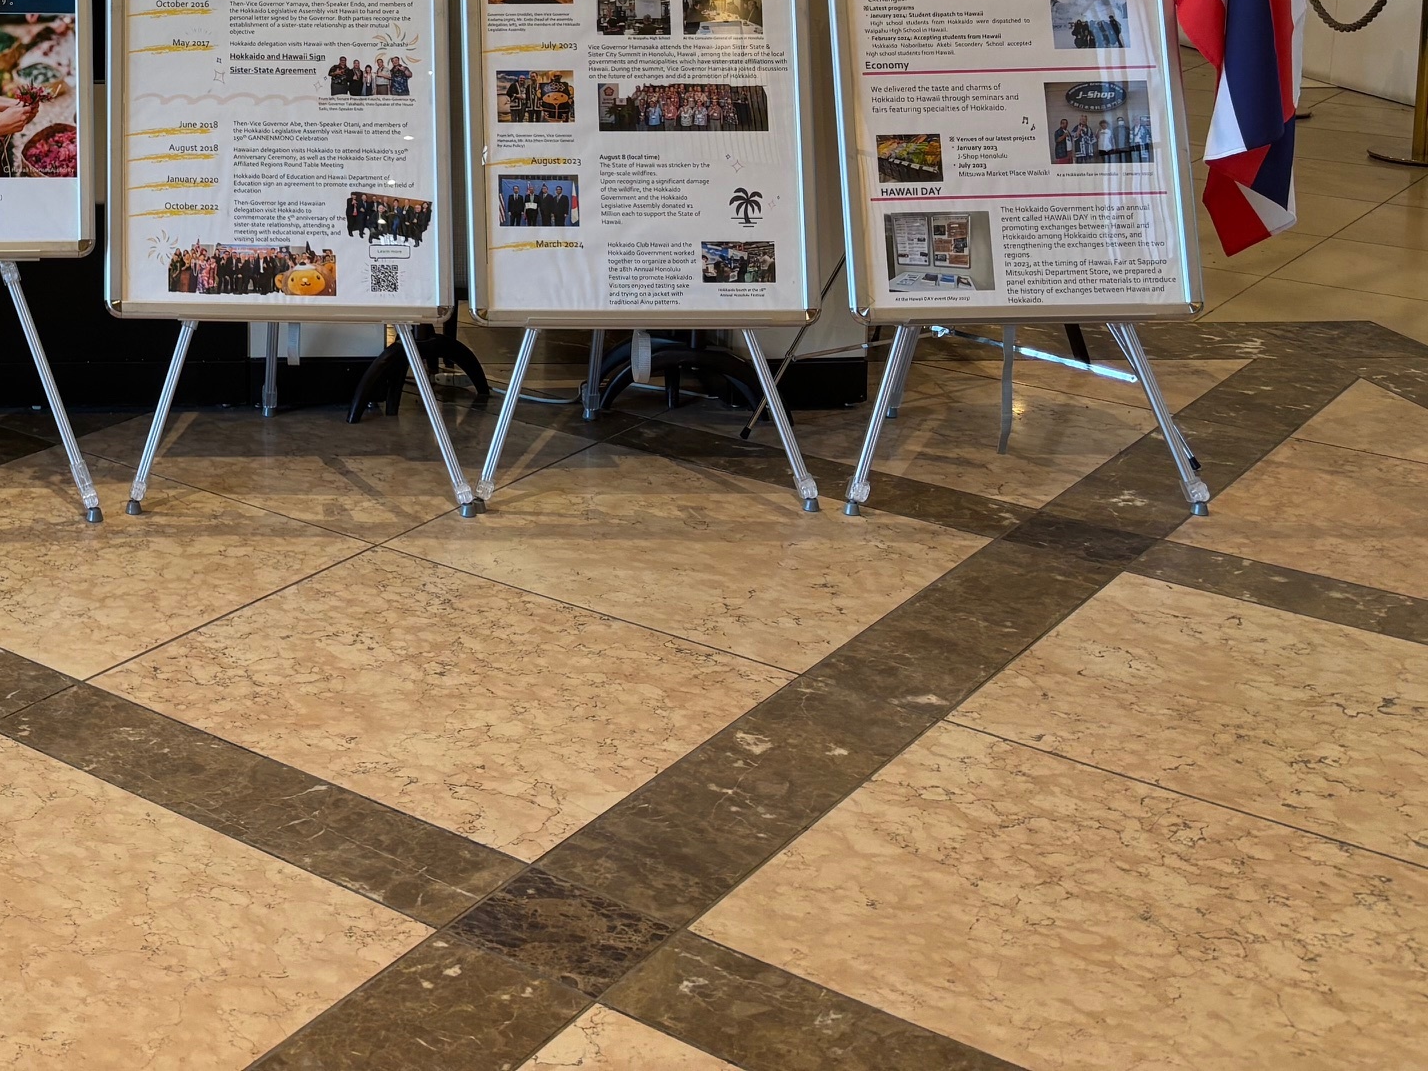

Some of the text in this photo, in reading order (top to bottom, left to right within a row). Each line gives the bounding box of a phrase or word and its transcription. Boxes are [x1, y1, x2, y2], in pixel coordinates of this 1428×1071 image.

[155, 0, 188, 7] October
[172, 38, 209, 48] May 2017
[539, 40, 577, 51] July 2023
[229, 52, 326, 62] Hokkaido and Hawaii Sign
[229, 66, 316, 75] Sister-State Agreement
[865, 61, 909, 72] Economy
[1075, 90, 1115, 100] J-Shop
[178, 120, 218, 128] June 2018
[168, 143, 218, 153] August 2018
[530, 155, 581, 168] August 2023
[166, 174, 197, 184] January
[880, 186, 942, 196] HAWAII DAY
[164, 201, 197, 210] October
[535, 239, 583, 249] March 2024
